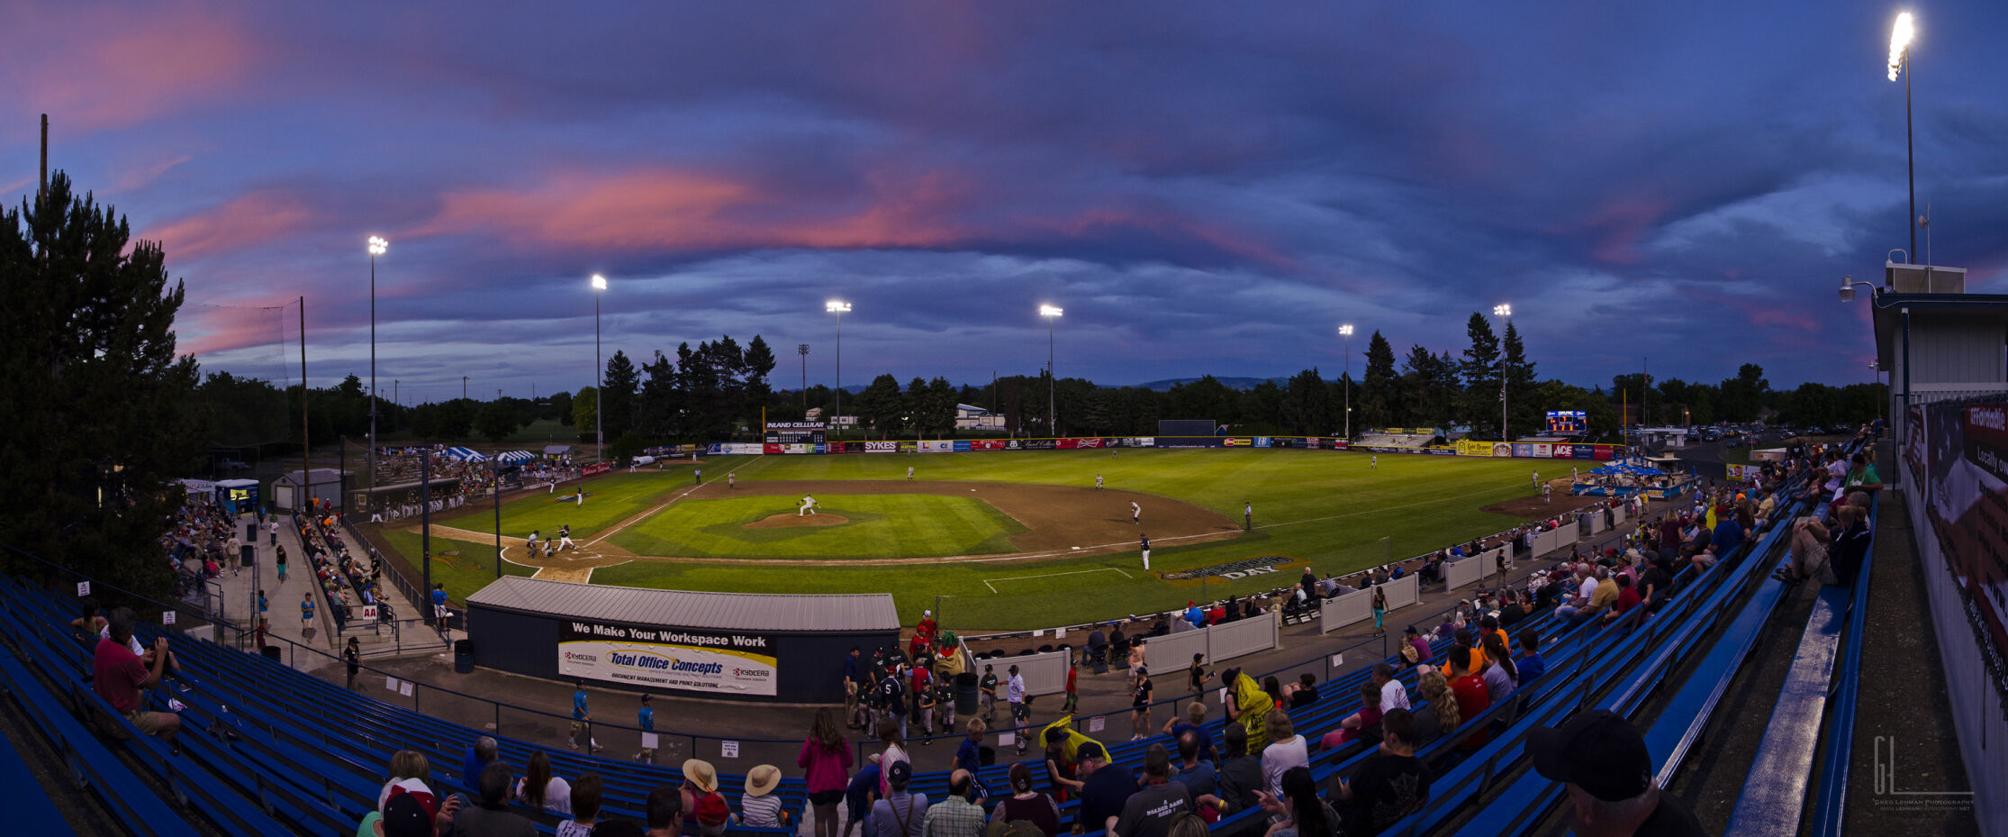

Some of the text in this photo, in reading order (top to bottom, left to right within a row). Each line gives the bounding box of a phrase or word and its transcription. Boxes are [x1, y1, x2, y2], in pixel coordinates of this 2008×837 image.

[1970, 408, 2005, 431] Affordable
[865, 441, 896, 450] SYKES
[1554, 445, 1573, 456] ACE
[1977, 445, 1998, 473] Locally
[364, 608, 376, 617] AA
[572, 622, 766, 648] We Make Your Workspace Work
[611, 652, 635, 667] Total
[638, 655, 669, 670] Office
[672, 658, 723, 675] Concepts
[637, 675, 668, 684] MANAGEMENT
[693, 681, 719, 689] SOLUTIONS
[885, 684, 892, 694] 5
